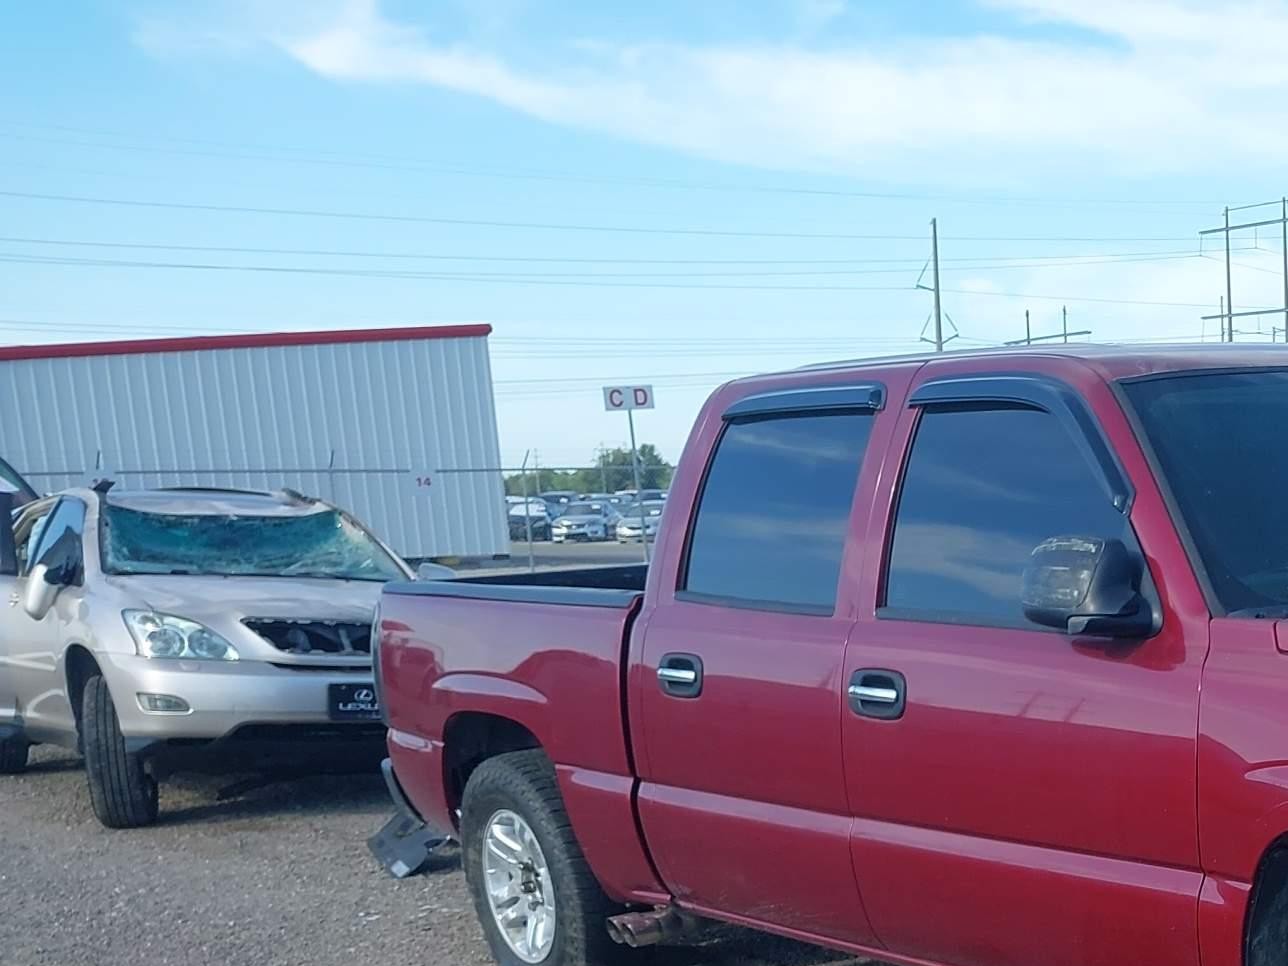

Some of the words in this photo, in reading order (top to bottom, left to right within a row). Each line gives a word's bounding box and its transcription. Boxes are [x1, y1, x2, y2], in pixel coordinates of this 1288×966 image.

[610, 389, 624, 407] C
[633, 388, 648, 406] D
[339, 702, 379, 711] LEXU
